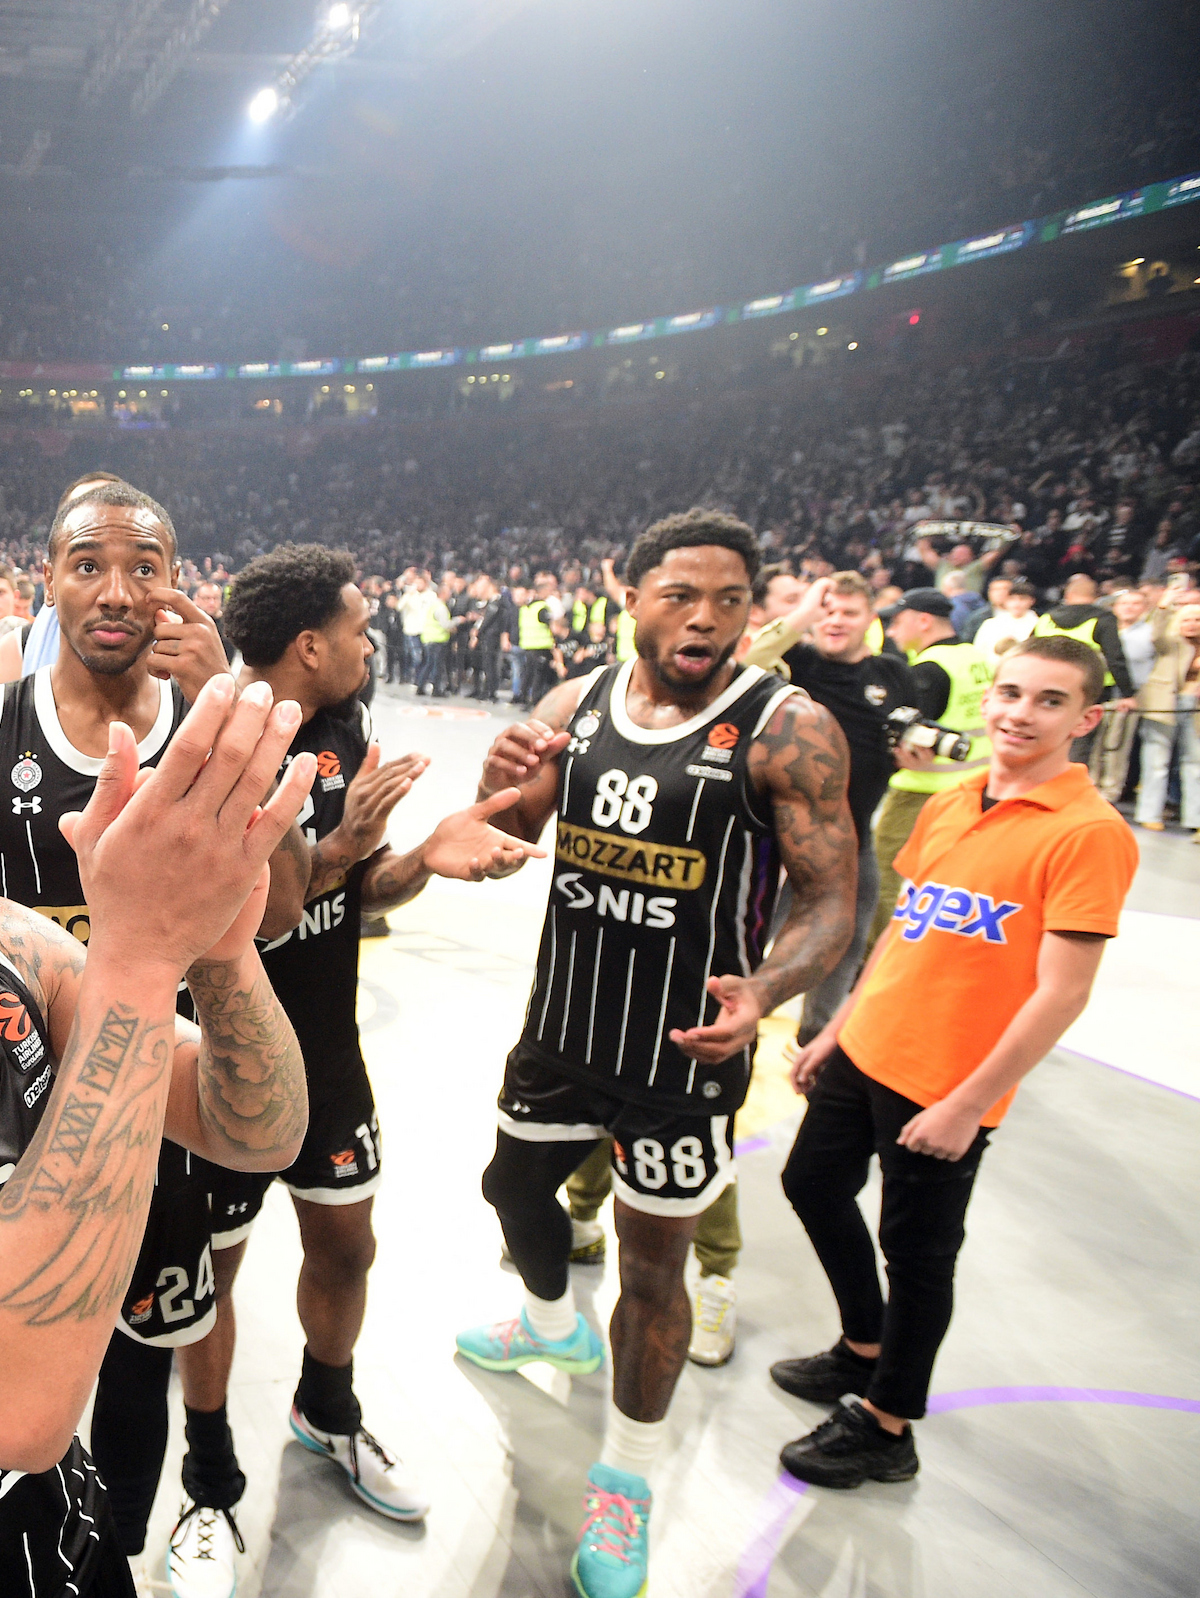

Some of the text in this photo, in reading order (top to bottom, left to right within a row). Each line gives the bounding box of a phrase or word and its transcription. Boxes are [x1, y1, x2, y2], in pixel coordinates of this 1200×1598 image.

[591, 768, 659, 835] 88
[557, 828, 700, 882] MOZZART
[299, 891, 346, 941] NIS
[598, 883, 678, 929] NIS
[632, 1135, 707, 1190] 88
[156, 1241, 216, 1324] 24
